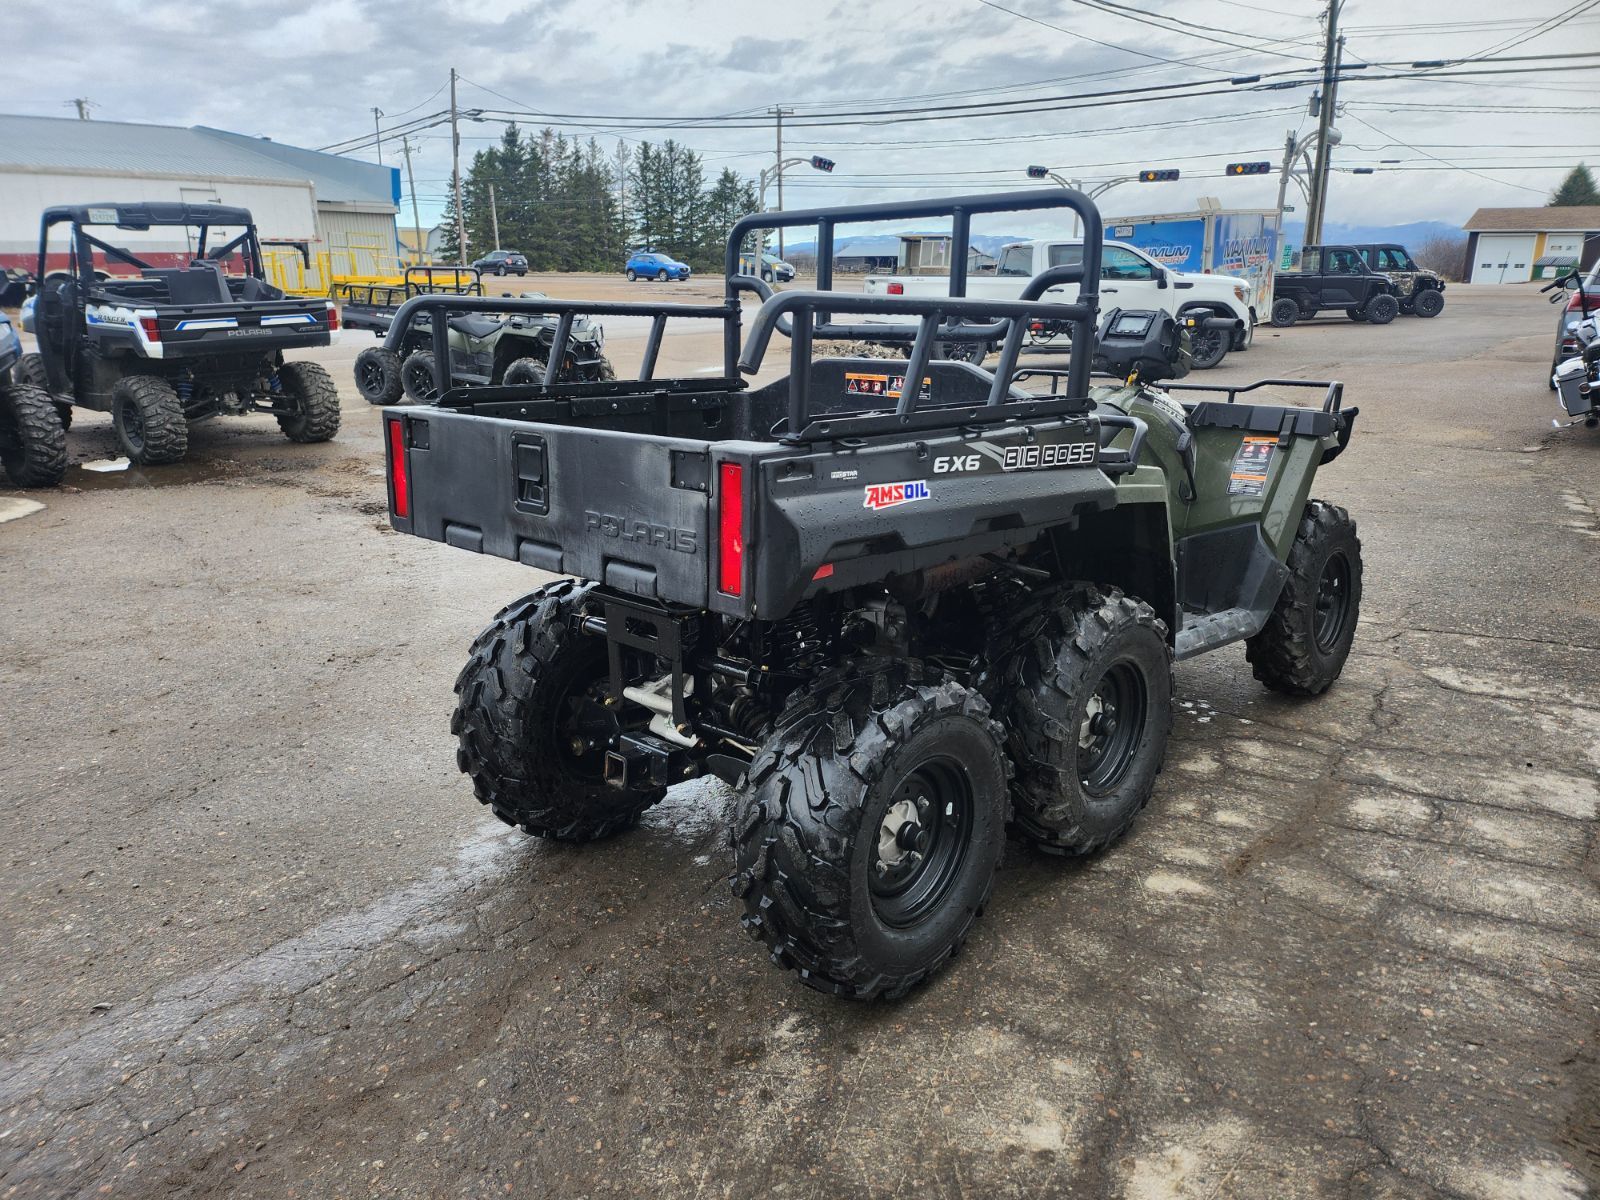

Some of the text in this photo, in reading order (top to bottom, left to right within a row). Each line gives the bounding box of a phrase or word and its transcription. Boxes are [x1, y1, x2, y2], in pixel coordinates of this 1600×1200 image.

[1141, 245, 1191, 258] IMUM
[1223, 236, 1272, 259] MAXIMUM
[97, 314, 126, 323] RANGER
[227, 328, 273, 337] POLARIS
[933, 442, 1096, 474] 6X6 BIG BOSS
[865, 481, 930, 509] AMSOIL
[584, 509, 698, 555] POLARIS
